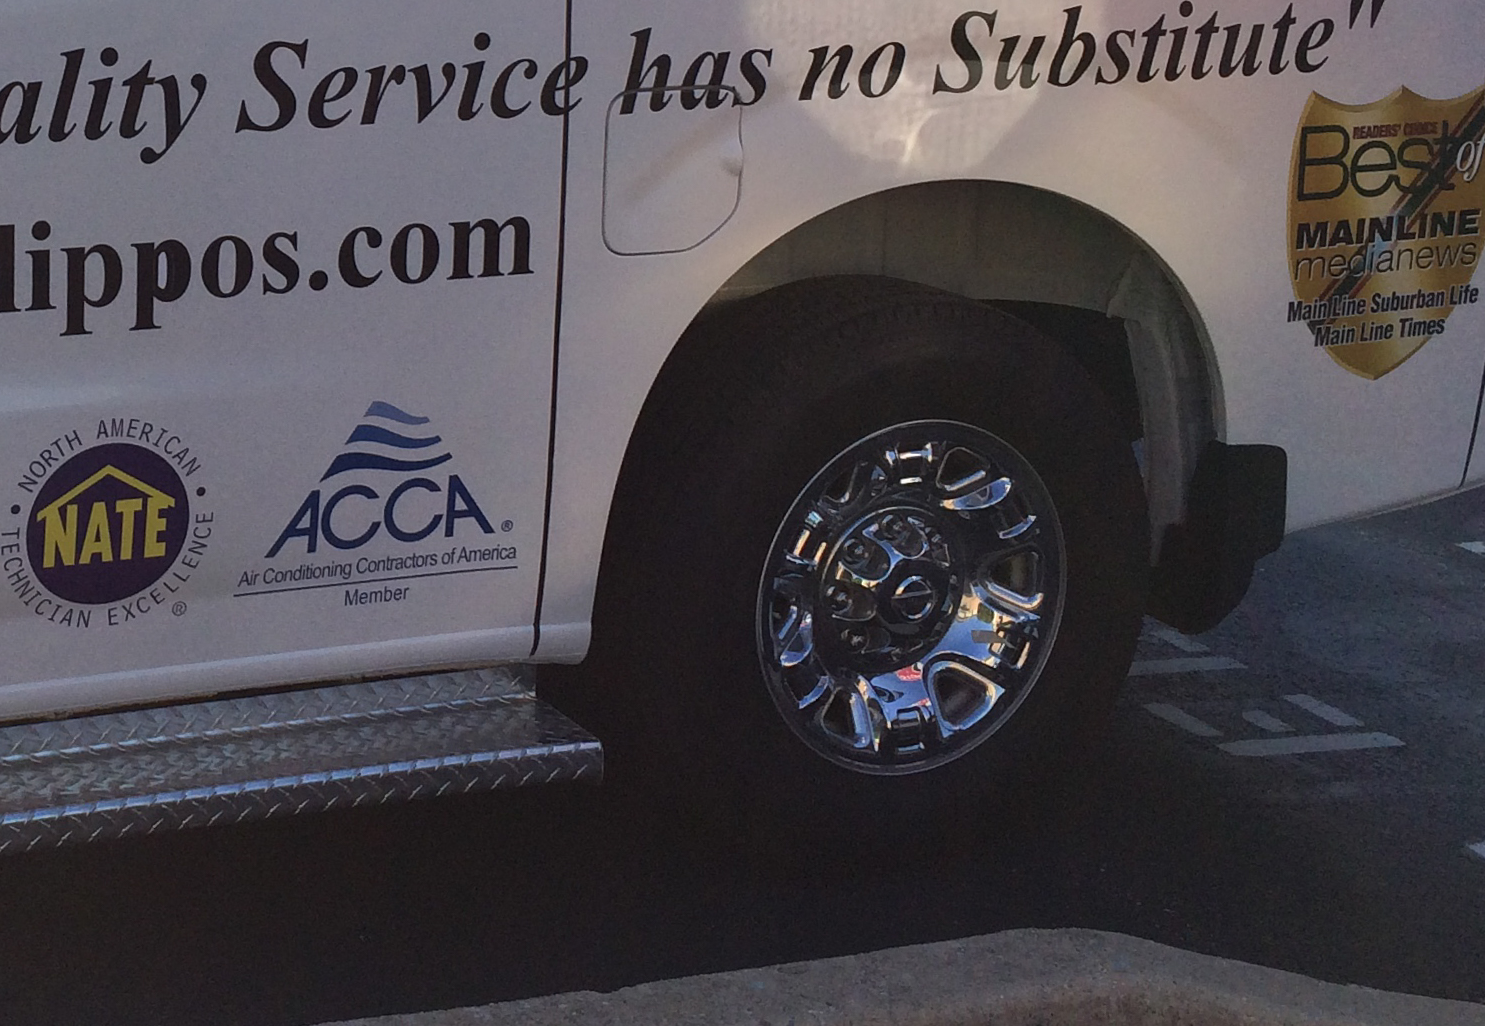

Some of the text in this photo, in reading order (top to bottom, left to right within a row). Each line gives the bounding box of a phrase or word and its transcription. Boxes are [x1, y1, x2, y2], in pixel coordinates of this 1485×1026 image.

[234, 31, 590, 135] Service
[618, 28, 773, 115] has
[797, 42, 907, 102] no
[1296, 119, 1456, 202] Best
[1294, 208, 1481, 250] MAINLINE
[1294, 241, 1478, 281] medianews
[1286, 283, 1480, 323] Main Line Suburban Life
[1313, 315, 1446, 348] Main Line Times
[17, 417, 202, 493] NORTH AMERICAN
[40, 496, 169, 569] NATE
[264, 474, 496, 559] ACCA
[0, 510, 215, 629] TECHNICIAN EXCELLENCE
[237, 543, 517, 588] Air Conditioning Contractors of America
[343, 586, 410, 607] Member
